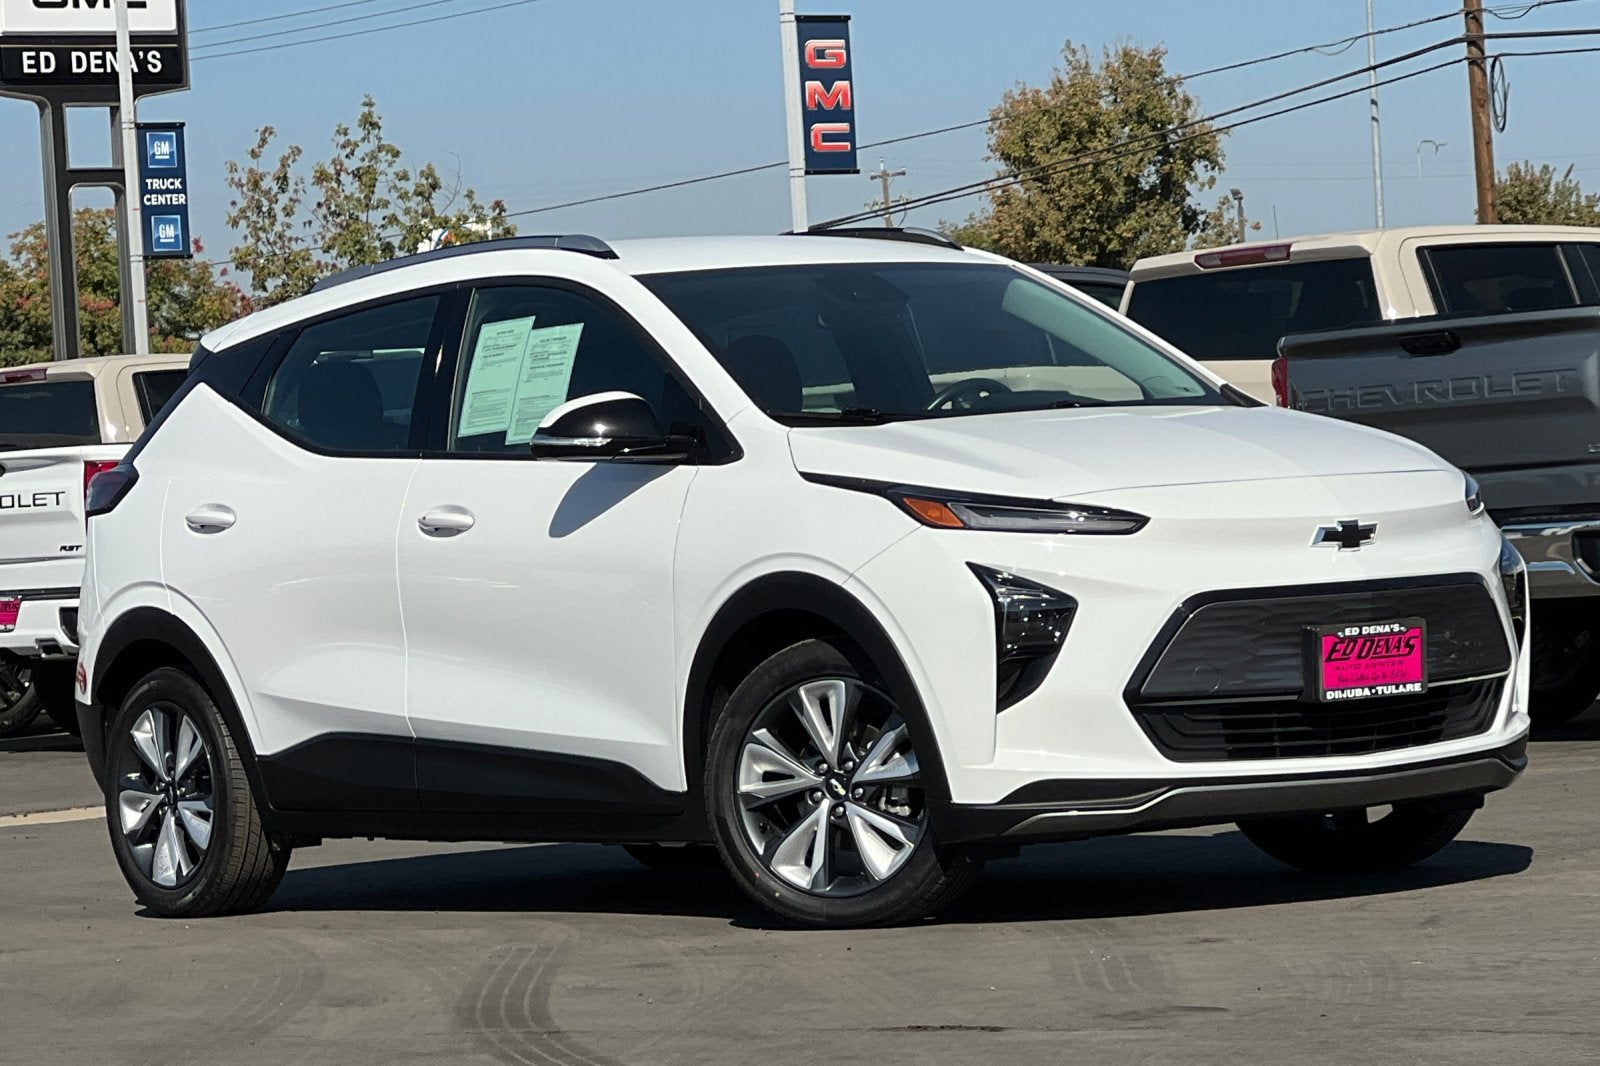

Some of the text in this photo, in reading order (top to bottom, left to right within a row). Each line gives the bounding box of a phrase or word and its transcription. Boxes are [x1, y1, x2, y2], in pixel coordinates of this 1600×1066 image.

[22, 51, 56, 74] ED
[804, 39, 852, 153] GMC
[154, 140, 170, 156] GM
[145, 178, 183, 190] TRUCK
[143, 193, 186, 206] CENTER
[158, 224, 175, 239] GM
[1301, 367, 1578, 412] CHEVROLET
[59, 544, 83, 552] RST
[1344, 623, 1401, 636] ED DENA'S
[1324, 640, 1357, 663] ED
[1376, 682, 1422, 695] TULARE
